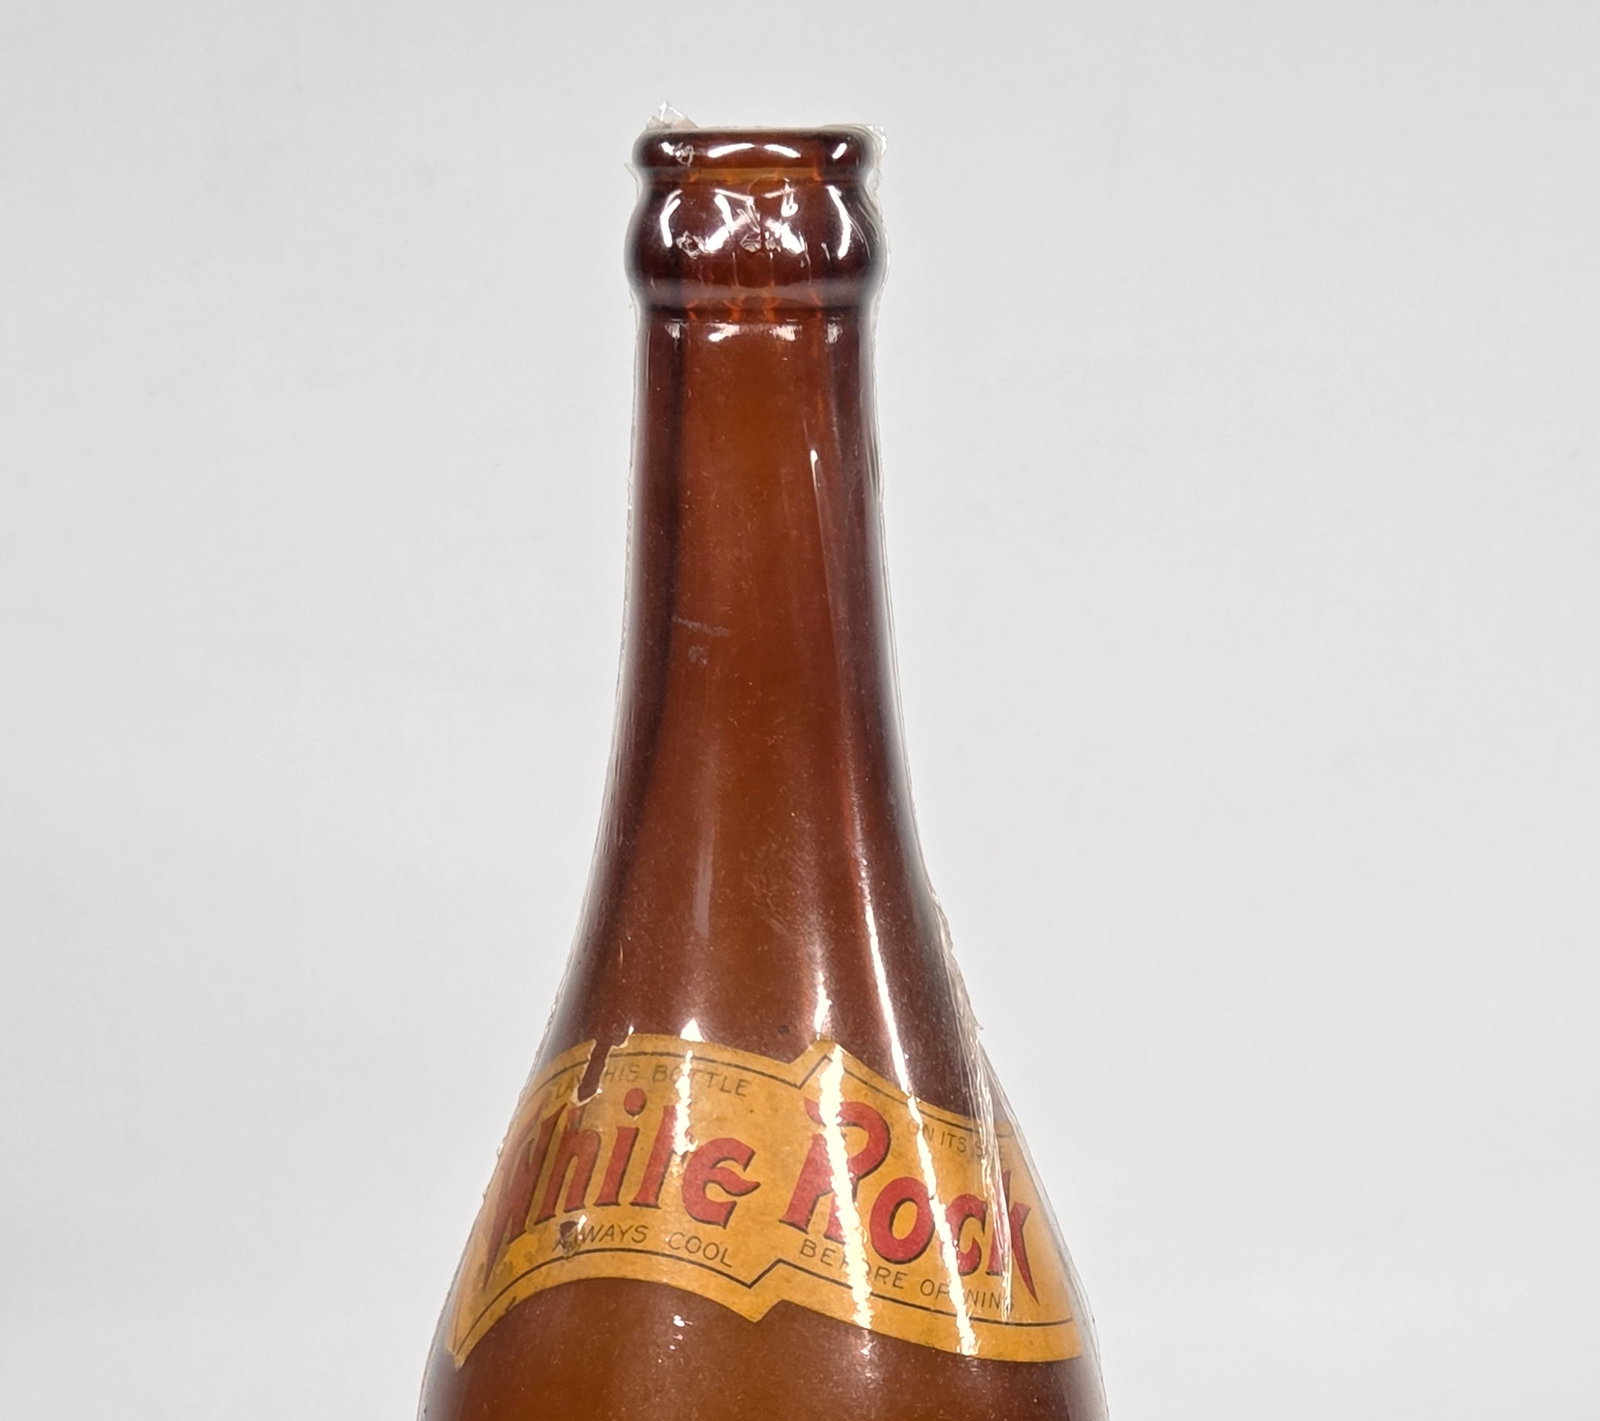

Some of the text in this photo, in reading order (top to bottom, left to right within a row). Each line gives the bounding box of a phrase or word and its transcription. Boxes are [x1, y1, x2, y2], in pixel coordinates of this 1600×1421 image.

[602, 1062, 641, 1084] HIS
[940, 1131, 967, 1153] ITS
[484, 1087, 1040, 1305] White Rock
[668, 1231, 733, 1268] COOL
[800, 1237, 908, 1290] BERE
